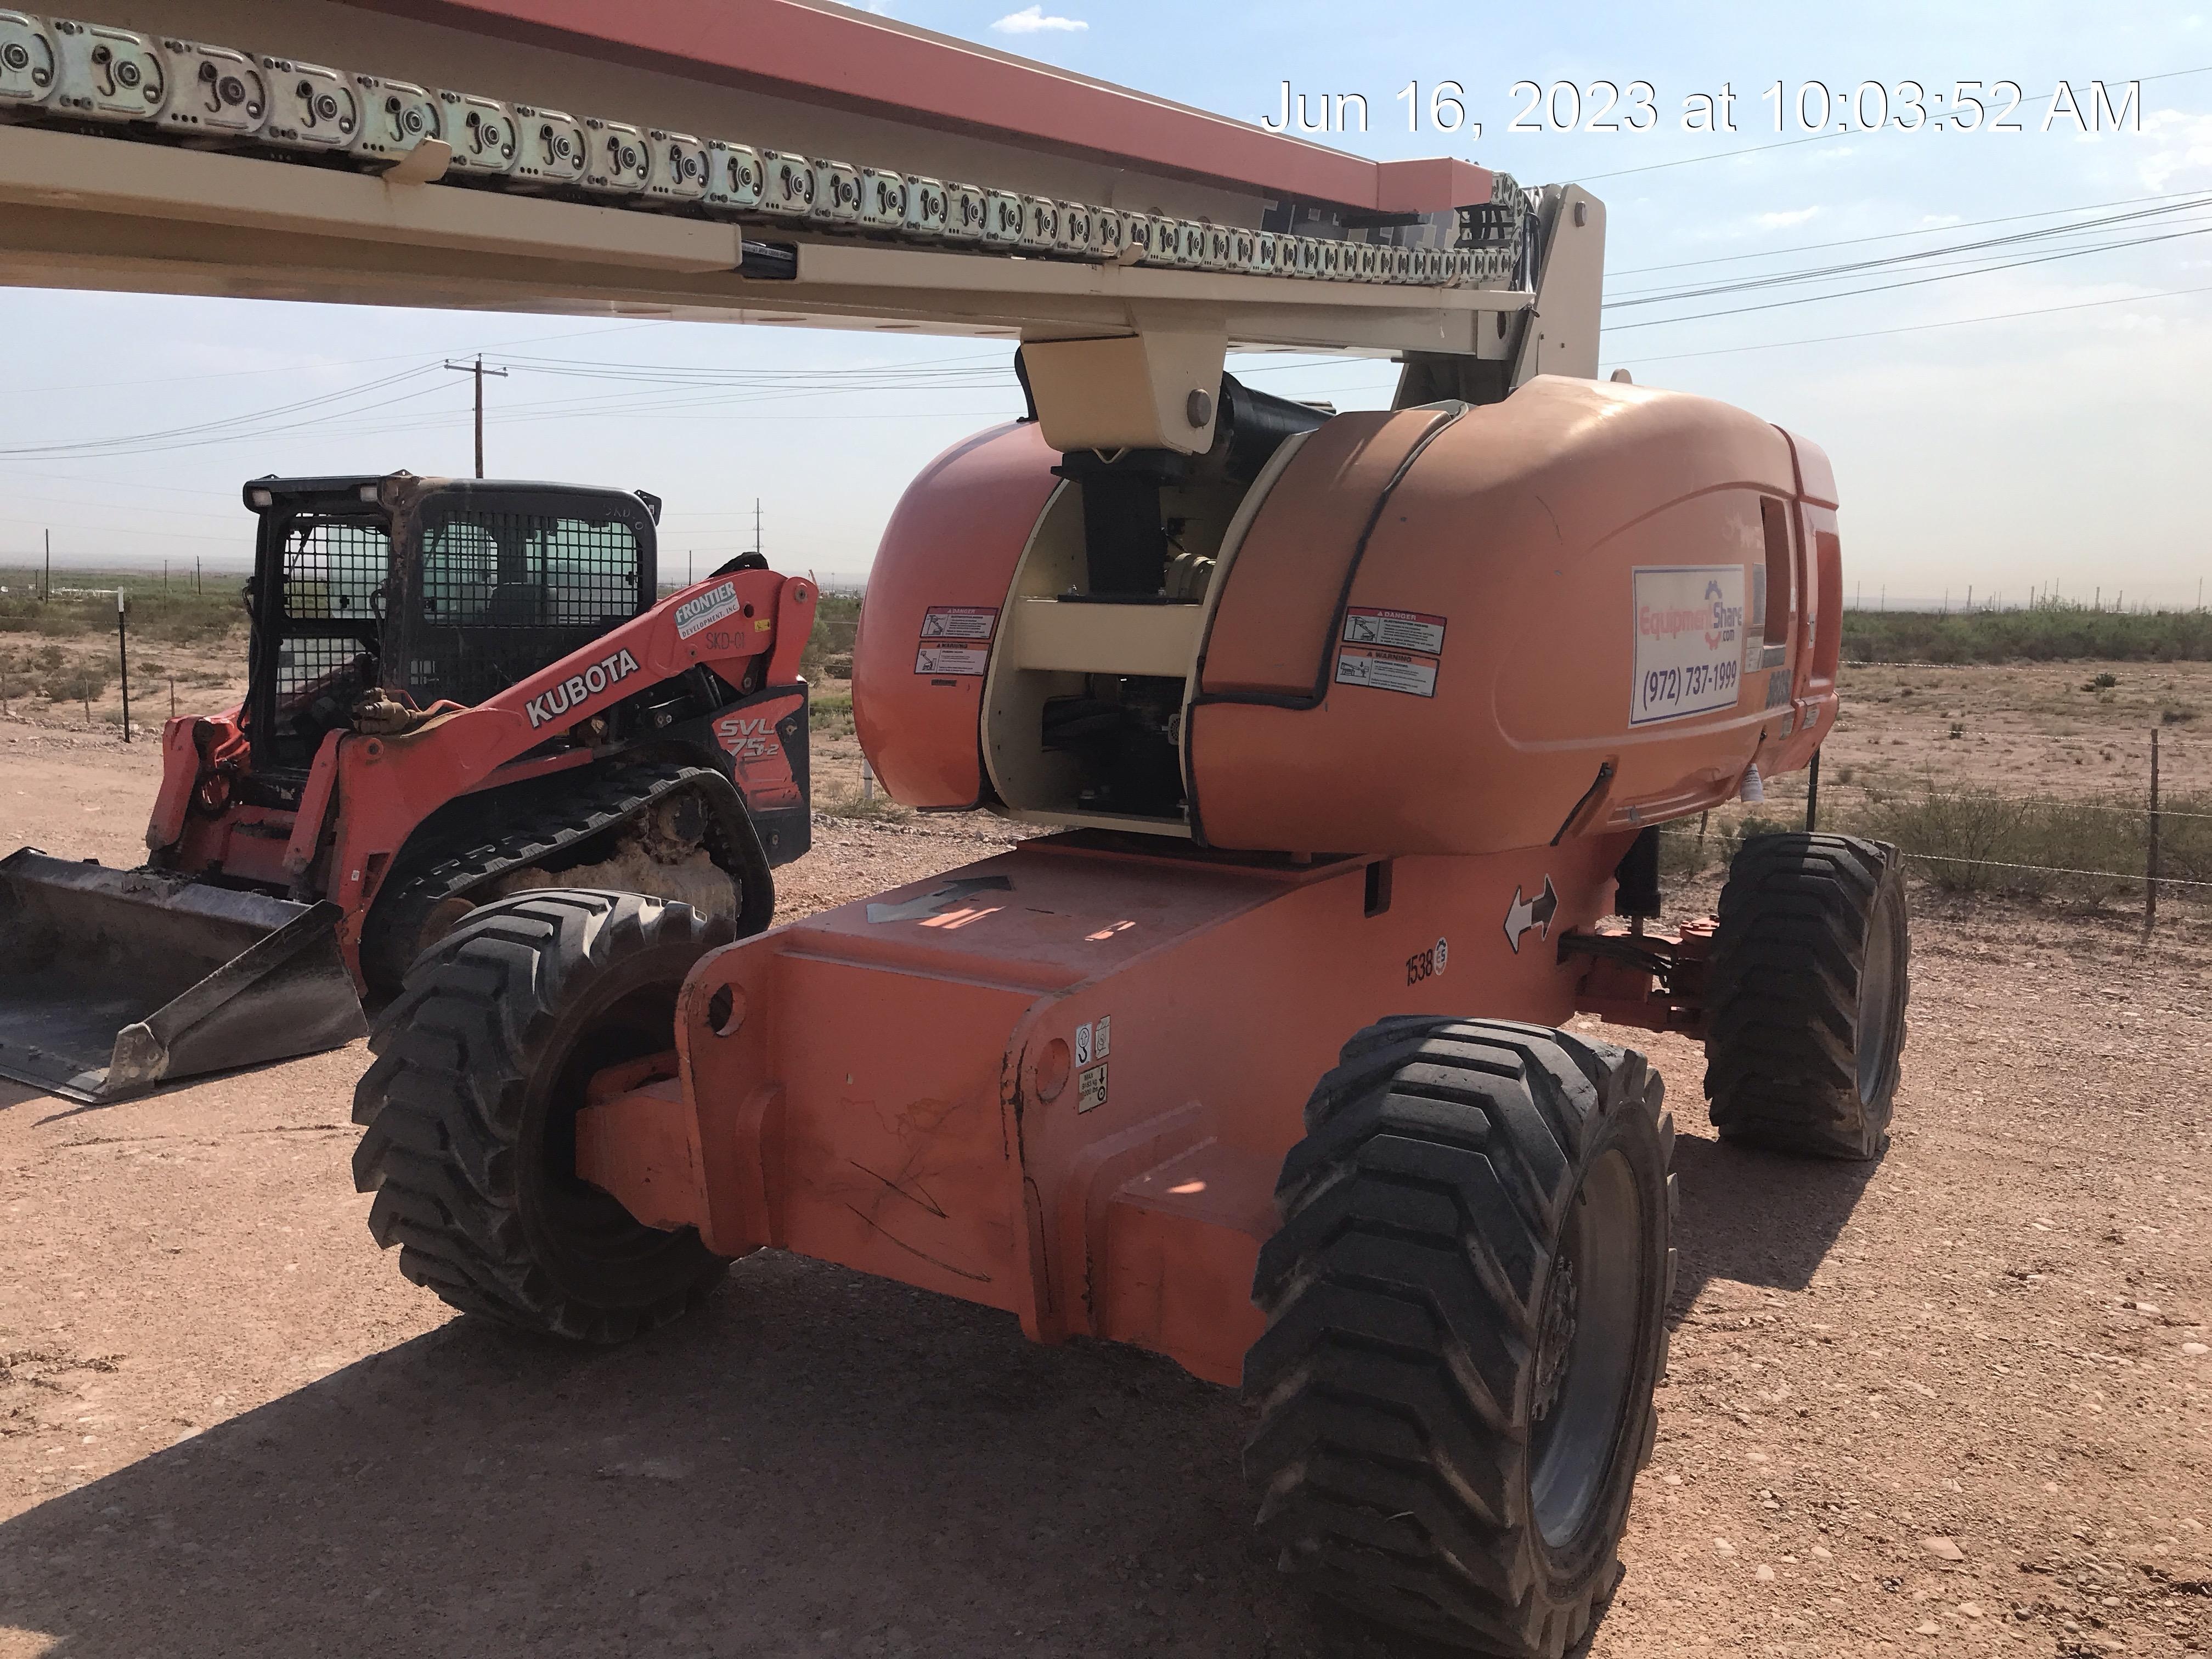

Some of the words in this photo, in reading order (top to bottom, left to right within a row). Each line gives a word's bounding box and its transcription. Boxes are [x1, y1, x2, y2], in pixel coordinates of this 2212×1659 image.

[675, 581, 736, 623] FRONTIER
[1384, 611, 1417, 620] DANGER
[682, 612, 725, 637] DEVELOPMENT,
[1375, 652, 1412, 663] WARNING
[526, 650, 639, 728] KUBOTA
[1643, 666, 1681, 712] (972)
[1685, 660, 1737, 696] 737-1999
[718, 718, 775, 737] SVL
[1406, 949, 1433, 986] 1538
